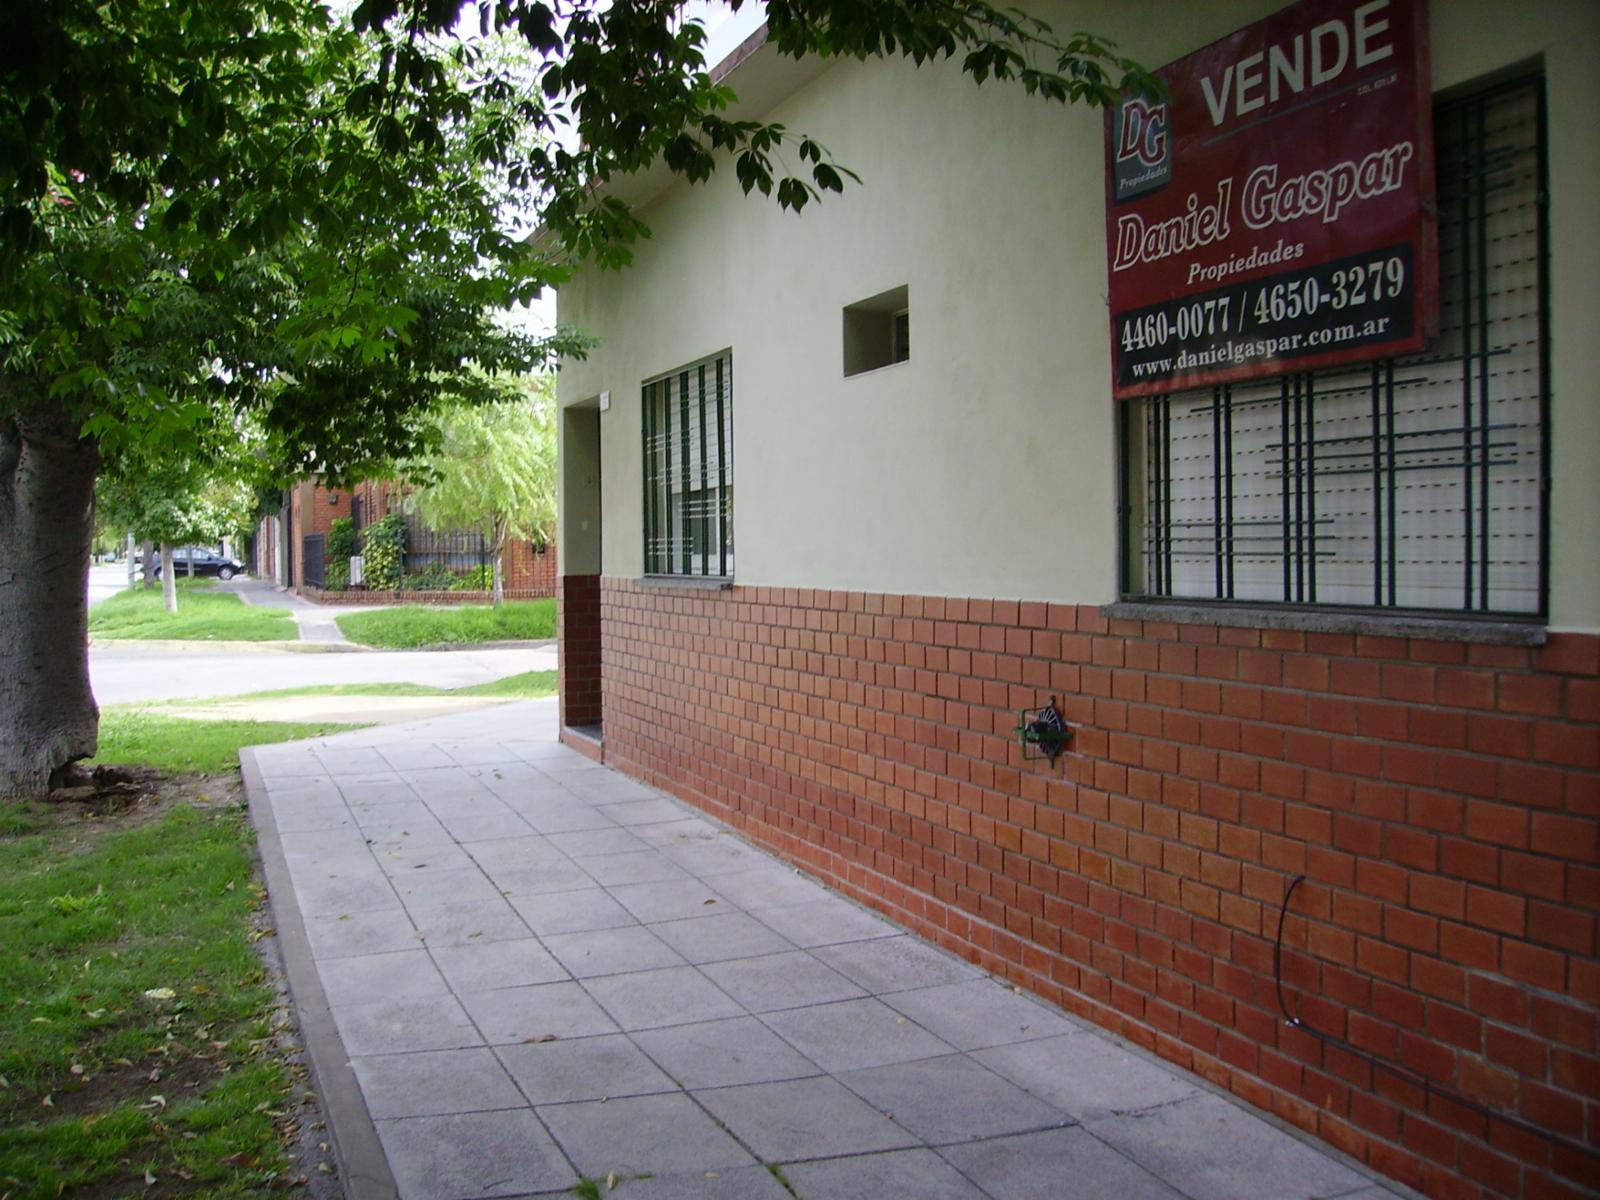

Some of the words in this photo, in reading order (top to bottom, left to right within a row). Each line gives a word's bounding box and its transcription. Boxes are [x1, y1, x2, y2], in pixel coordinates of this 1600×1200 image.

[1200, 0, 1393, 126] VENDE
[1116, 99, 1167, 167] DG
[1113, 179, 1232, 271] Daniel
[1241, 141, 1414, 229] Gaspar
[1187, 239, 1305, 285] Propiedades
[1121, 296, 1231, 353] 4460-0077
[1253, 257, 1405, 326] 4650-3279
[1132, 314, 1390, 378] www.danielgaspar.com.ar
